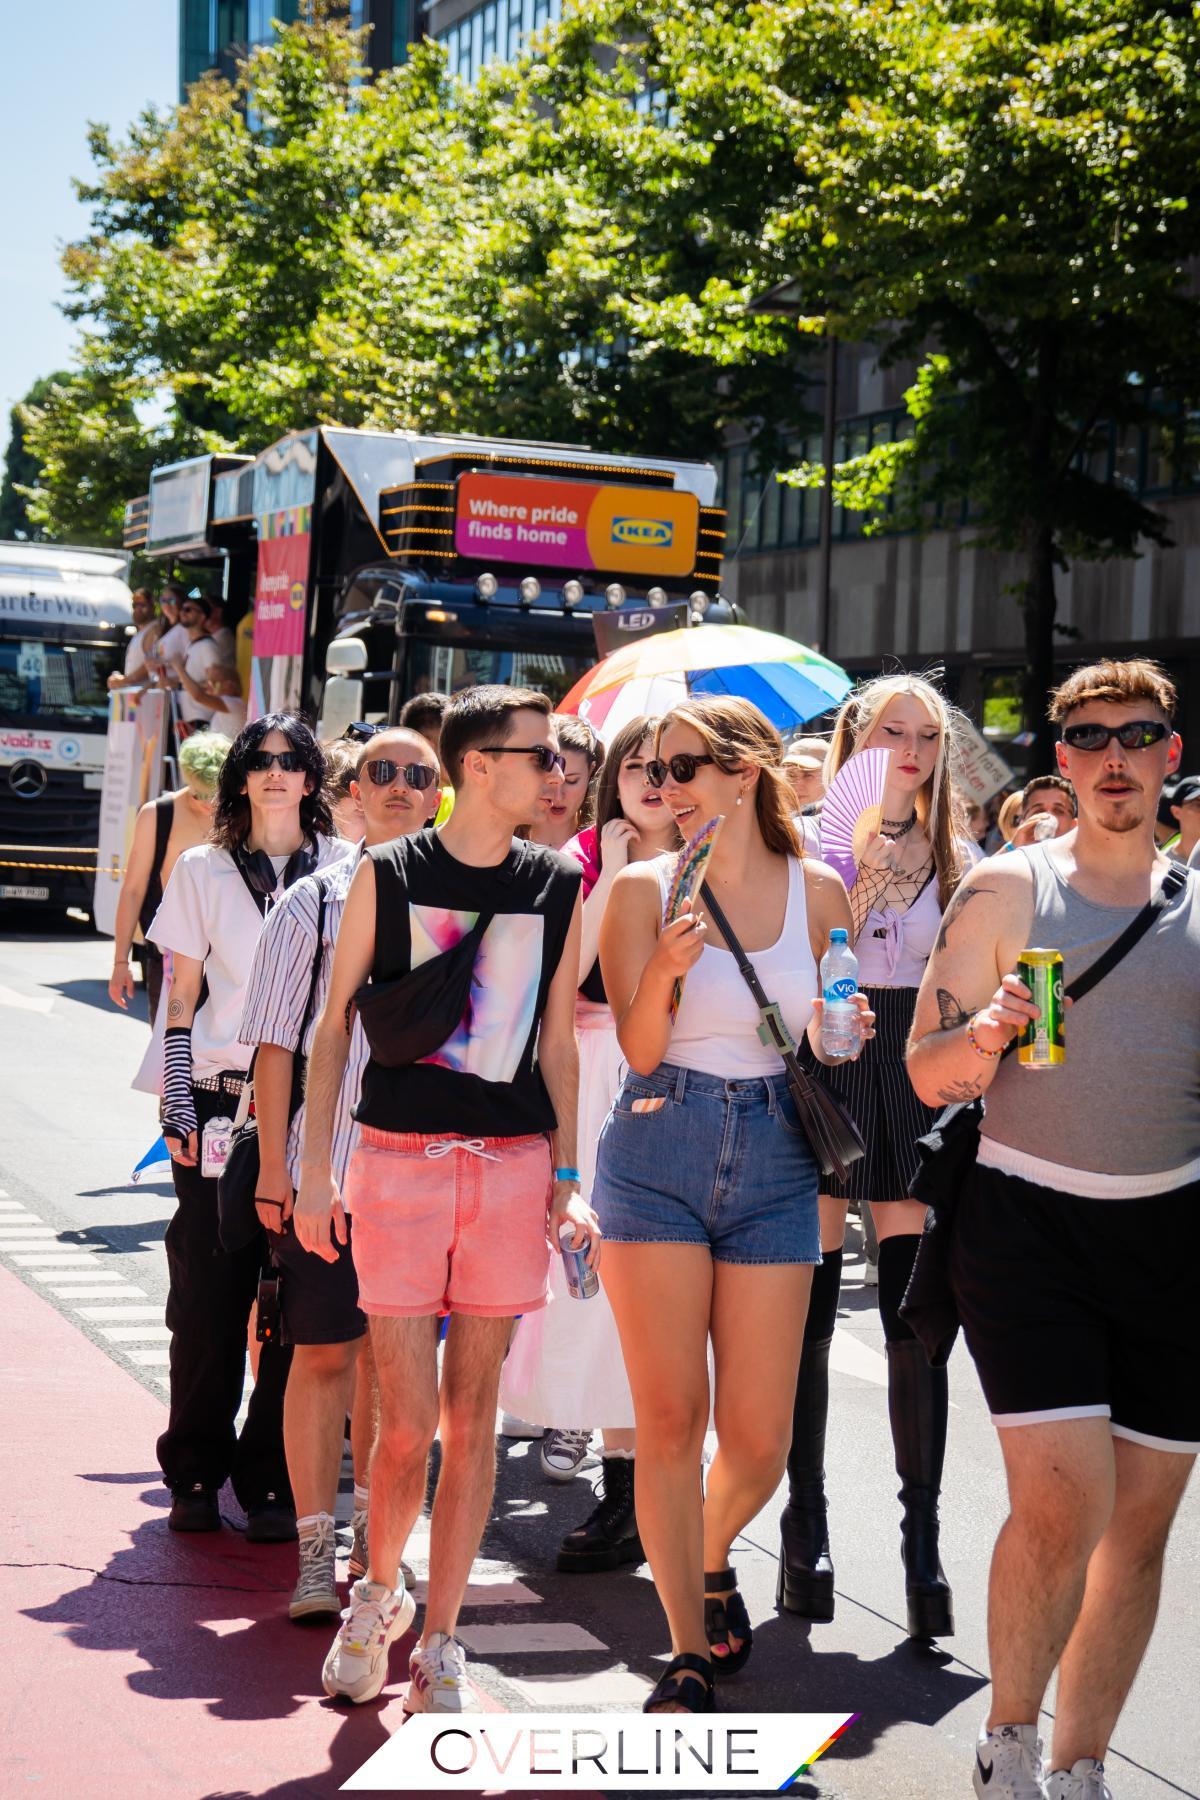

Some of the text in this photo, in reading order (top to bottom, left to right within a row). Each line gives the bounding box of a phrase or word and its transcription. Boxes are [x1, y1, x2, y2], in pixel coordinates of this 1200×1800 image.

[469, 499, 578, 525] Where pride
[468, 520, 568, 545] finds home
[618, 525, 667, 538] IKEA
[618, 612, 655, 630] LED
